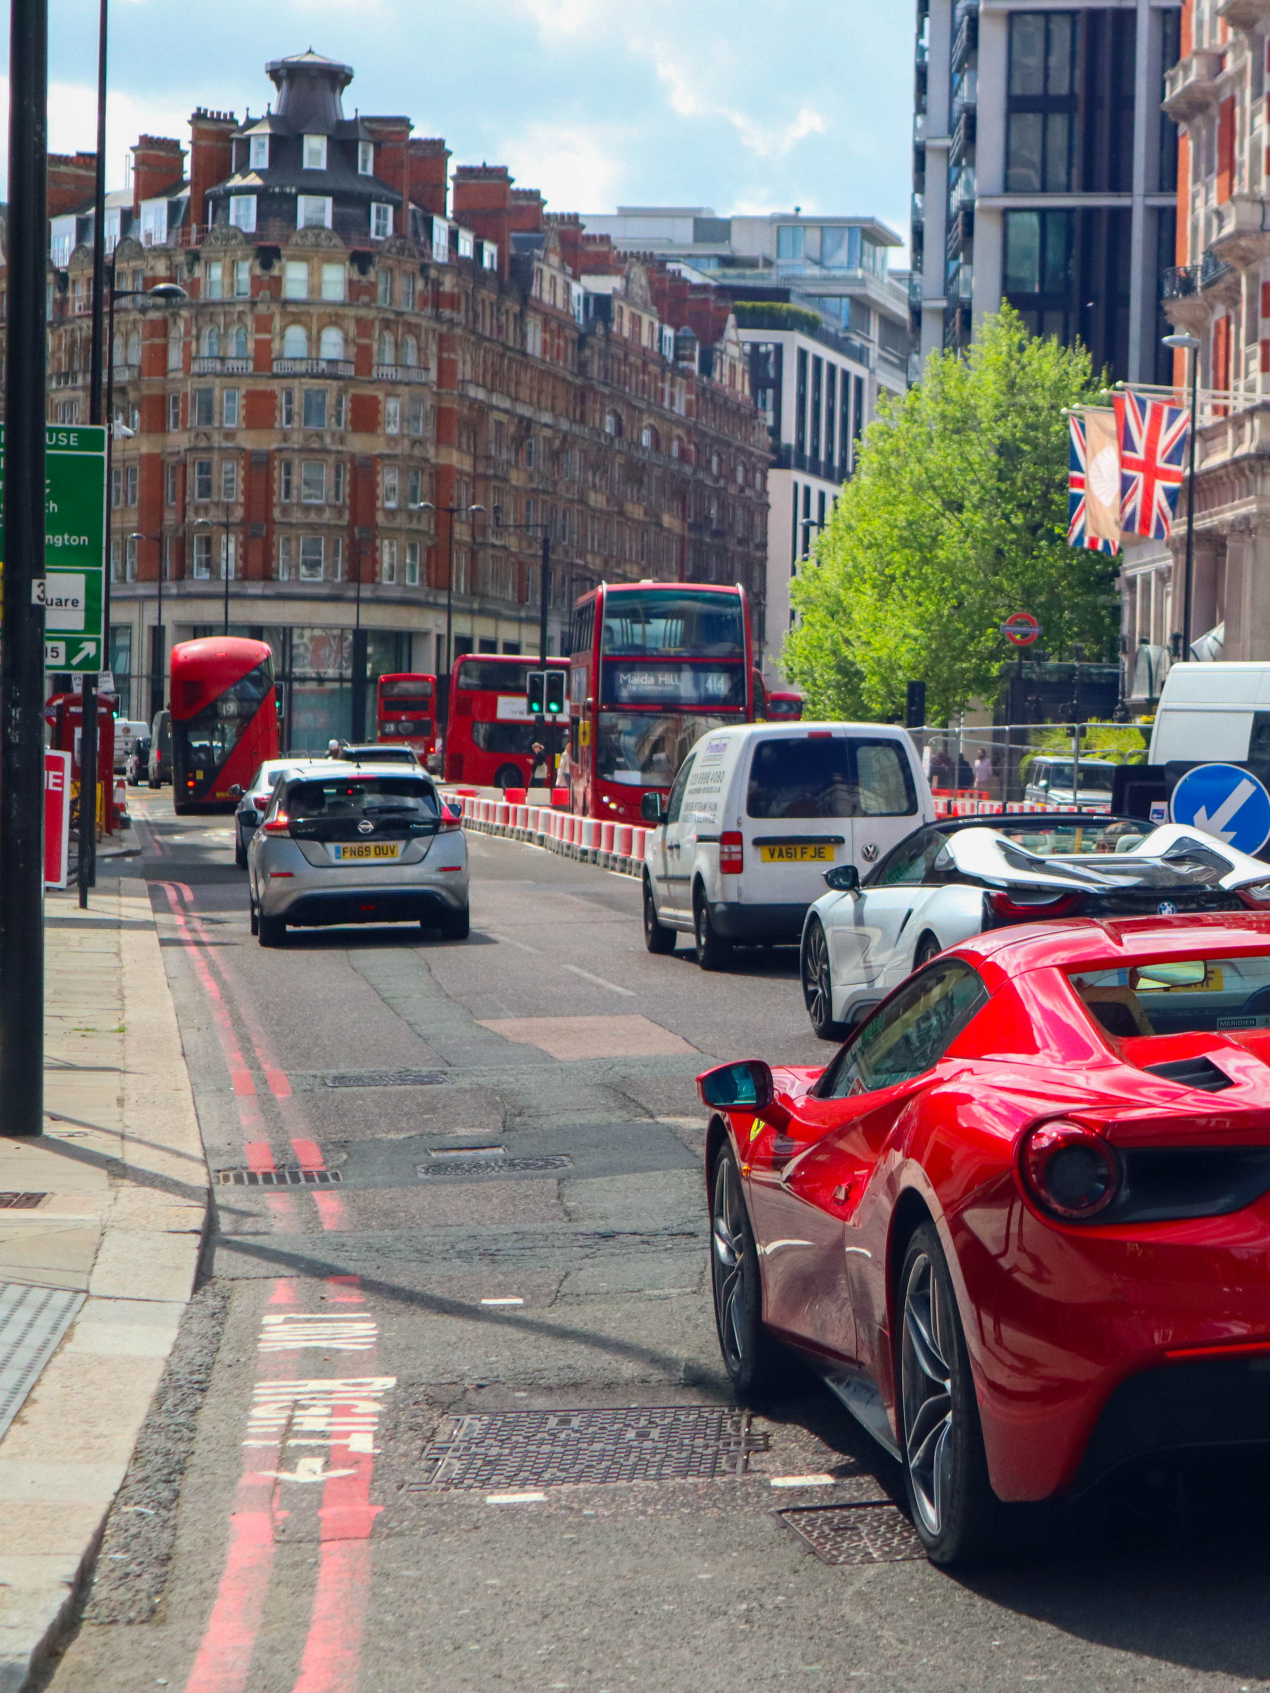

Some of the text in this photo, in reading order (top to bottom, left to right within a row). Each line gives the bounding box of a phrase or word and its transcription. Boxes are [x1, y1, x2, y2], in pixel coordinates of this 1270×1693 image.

[619, 673, 680, 685] Maida Hill
[705, 676, 725, 692] 414
[342, 845, 372, 857] FN69
[768, 847, 826, 859] VA61 FJE
[1219, 1018, 1256, 1028] MERIDIEN
